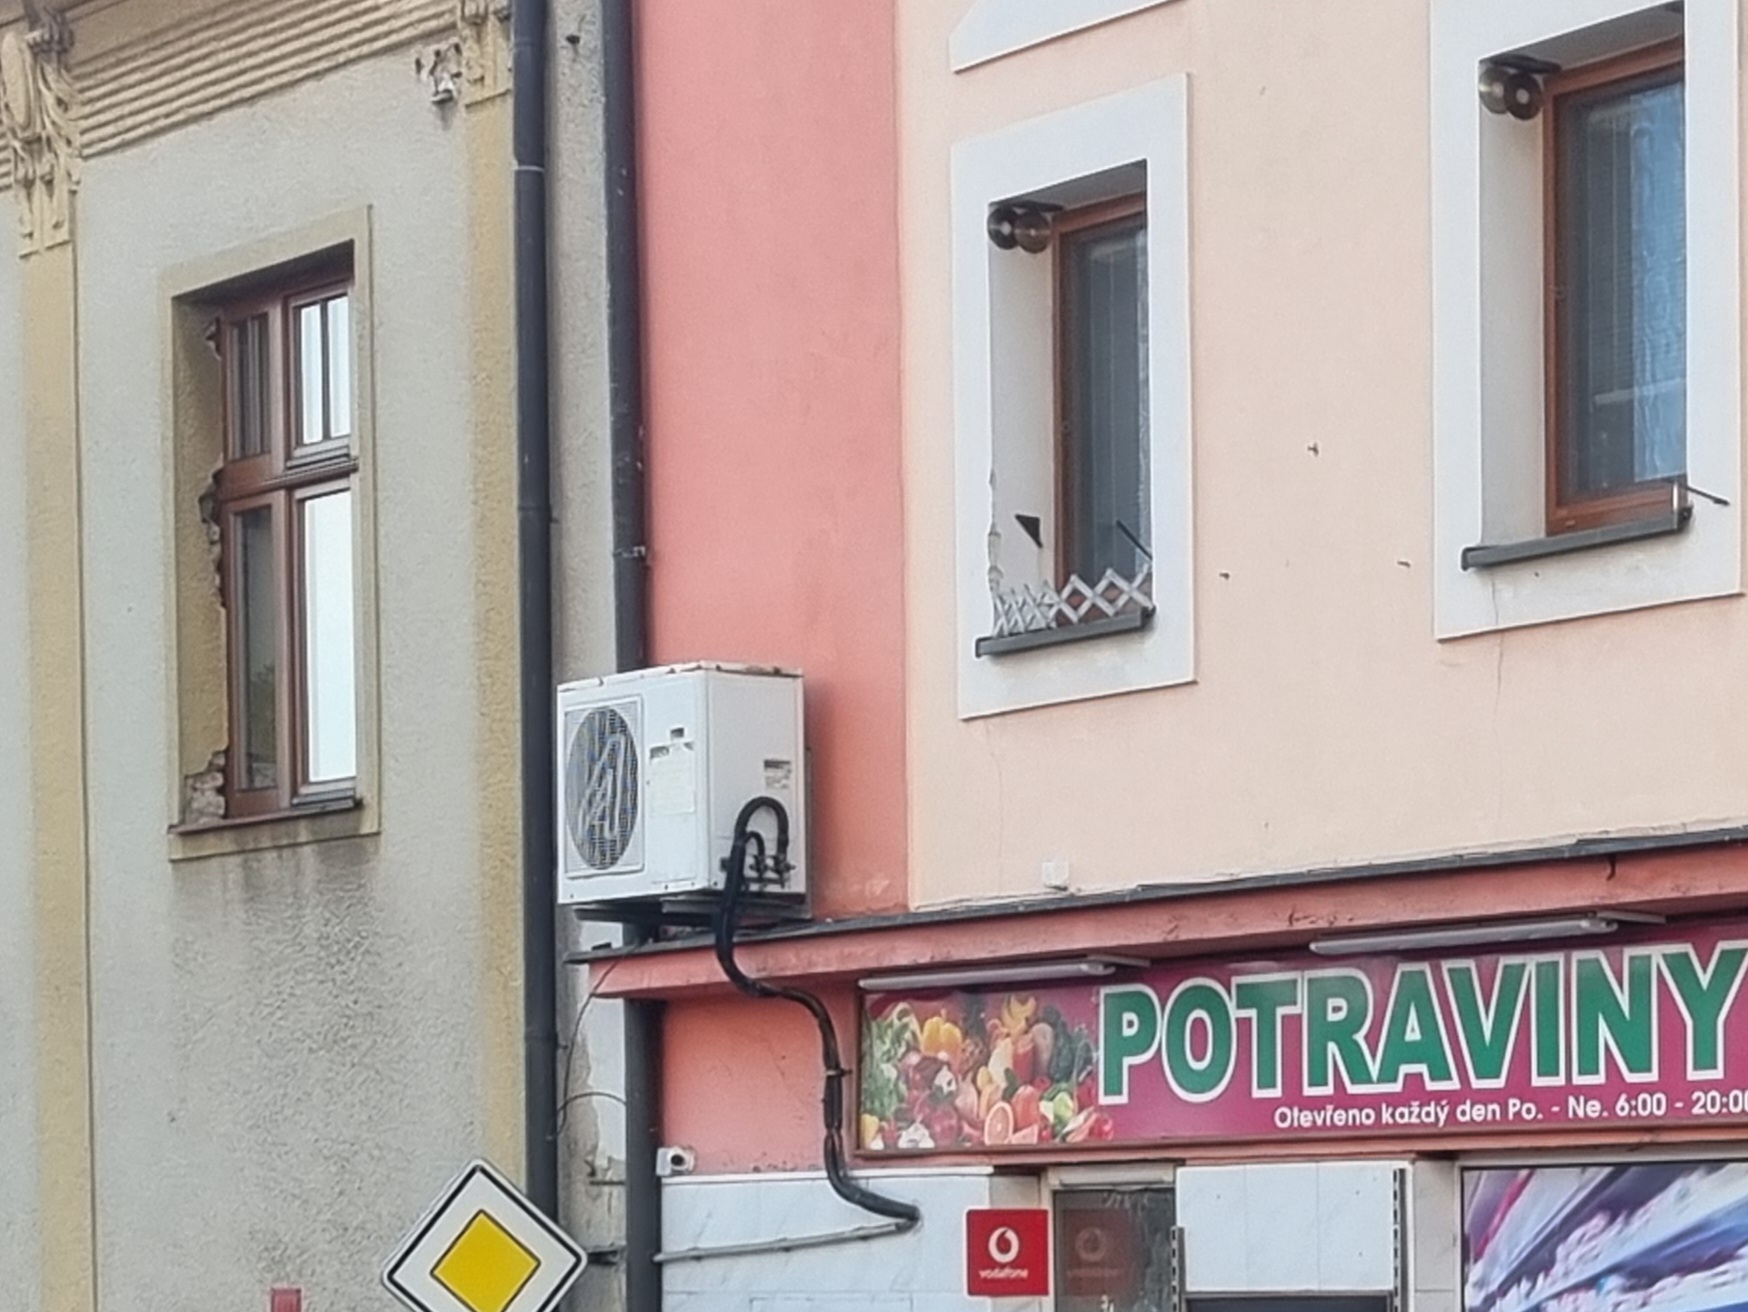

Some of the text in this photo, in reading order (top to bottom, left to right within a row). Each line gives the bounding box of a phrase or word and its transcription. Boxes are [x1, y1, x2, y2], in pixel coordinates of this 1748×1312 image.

[1274, 1102, 1375, 1129] Otevřeno
[1381, 1099, 1449, 1129] každý
[1456, 1099, 1501, 1123] den
[1507, 1098, 1544, 1121] Po.
[1567, 1096, 1608, 1119] Ne.
[1614, 1092, 1667, 1118] 6:00
